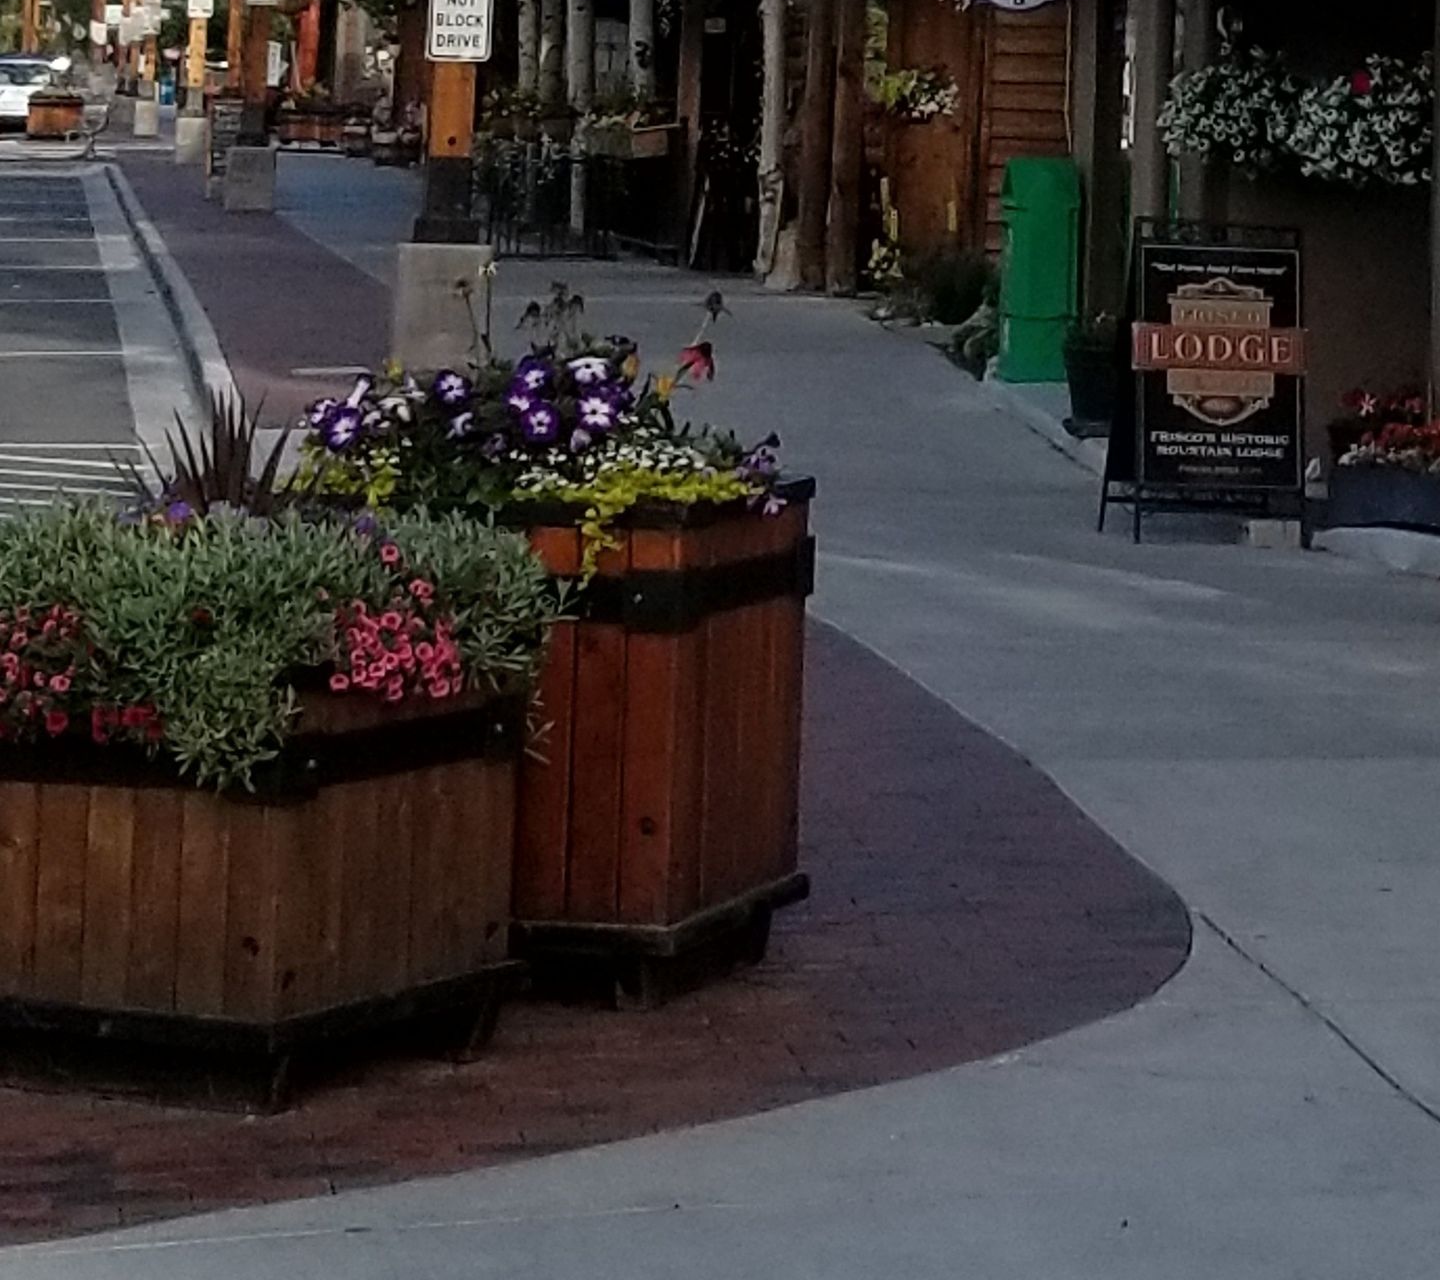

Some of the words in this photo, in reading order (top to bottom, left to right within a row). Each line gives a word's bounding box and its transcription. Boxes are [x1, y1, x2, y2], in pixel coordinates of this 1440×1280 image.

[436, 13, 484, 28] BLOCK
[436, 33, 481, 48] DRIVE
[1151, 332, 1294, 364] LODGE
[1220, 432, 1290, 446] HISTORIC
[1156, 444, 1233, 458] MOUNTAIN
